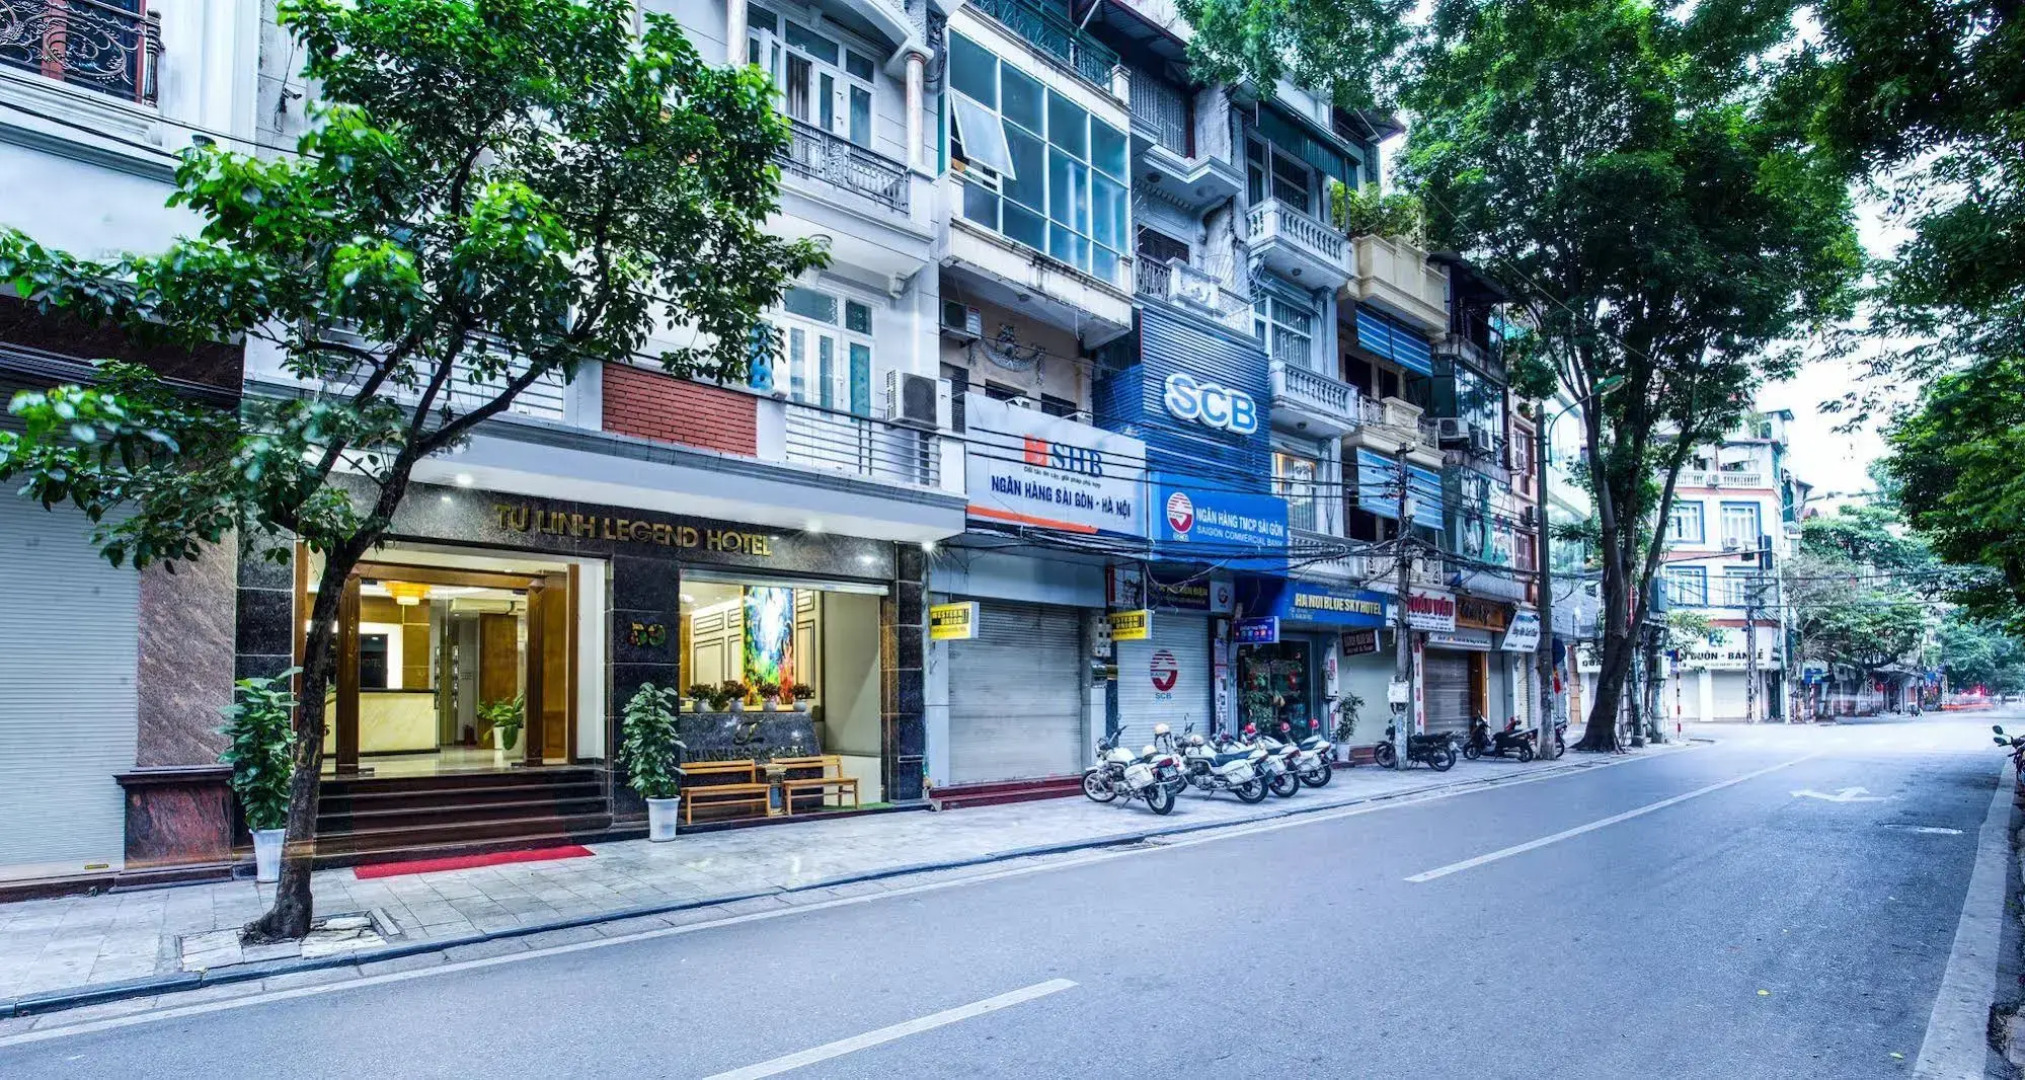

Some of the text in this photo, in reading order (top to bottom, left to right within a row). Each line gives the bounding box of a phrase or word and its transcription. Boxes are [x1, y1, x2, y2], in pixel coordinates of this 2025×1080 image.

[1166, 374, 1257, 434] SCB
[1052, 442, 1102, 478] SHB
[991, 474, 1022, 496] NGÂN
[1025, 481, 1051, 501] HÀNG
[1055, 487, 1072, 506] SÀI
[1075, 492, 1094, 510] GÒN
[1101, 496, 1113, 513] HÀ
[1116, 499, 1131, 519] NỘI
[537, 511, 596, 539] LINH
[604, 518, 699, 548] LEGEND
[707, 529, 772, 556] HOTEL
[1195, 507, 1284, 537] NGÂN HÀNG TMCP SÀI GÒN
[1196, 525, 1284, 547] SAIGON COMMERCIAL BANK
[1324, 596, 1344, 611] BLUE
[1345, 598, 1360, 612] SKY
[1360, 601, 1382, 615] HOTEL
[1155, 692, 1172, 700] SCB
